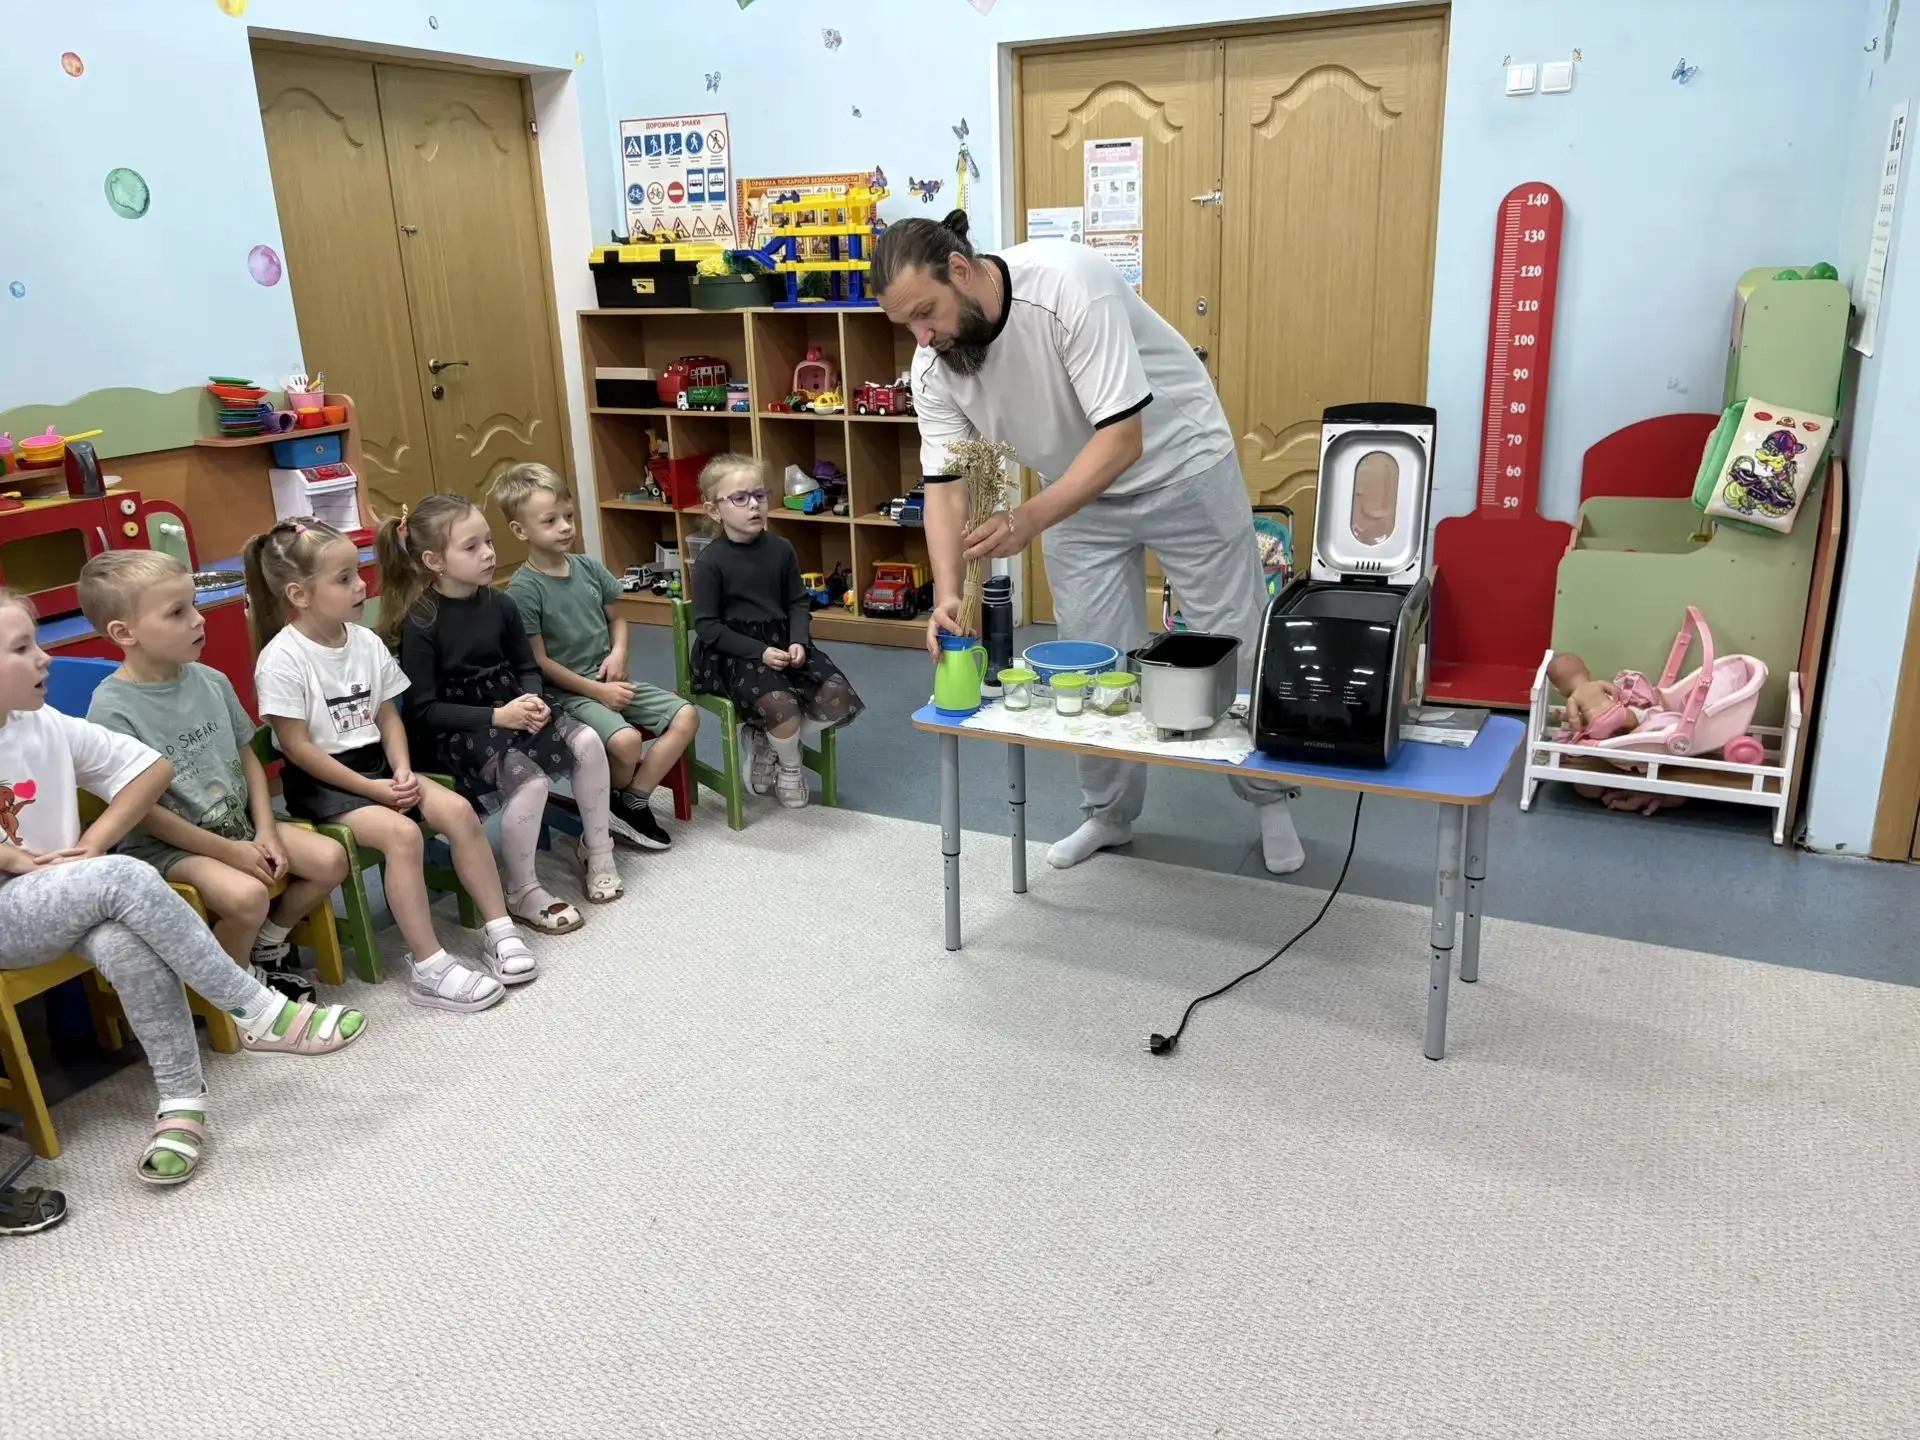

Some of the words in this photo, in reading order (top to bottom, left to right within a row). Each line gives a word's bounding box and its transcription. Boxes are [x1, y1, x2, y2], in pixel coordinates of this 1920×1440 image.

[646, 121, 680, 129] ДОРОЖНЫЕ
[811, 176, 859, 184] БЕЗОПАСНОСТИ
[1527, 193, 1549, 206] 140
[1523, 230, 1545, 243] 130
[1520, 265, 1542, 277] 120
[1517, 300, 1538, 311] 110
[1513, 335, 1534, 346] 100
[1513, 368, 1529, 381] 90
[1510, 402, 1526, 414] 80
[1507, 434, 1522, 446] 70
[1506, 465, 1521, 477] 60
[1503, 497, 1519, 508] 50
[178, 721, 219, 749] SAFARI
